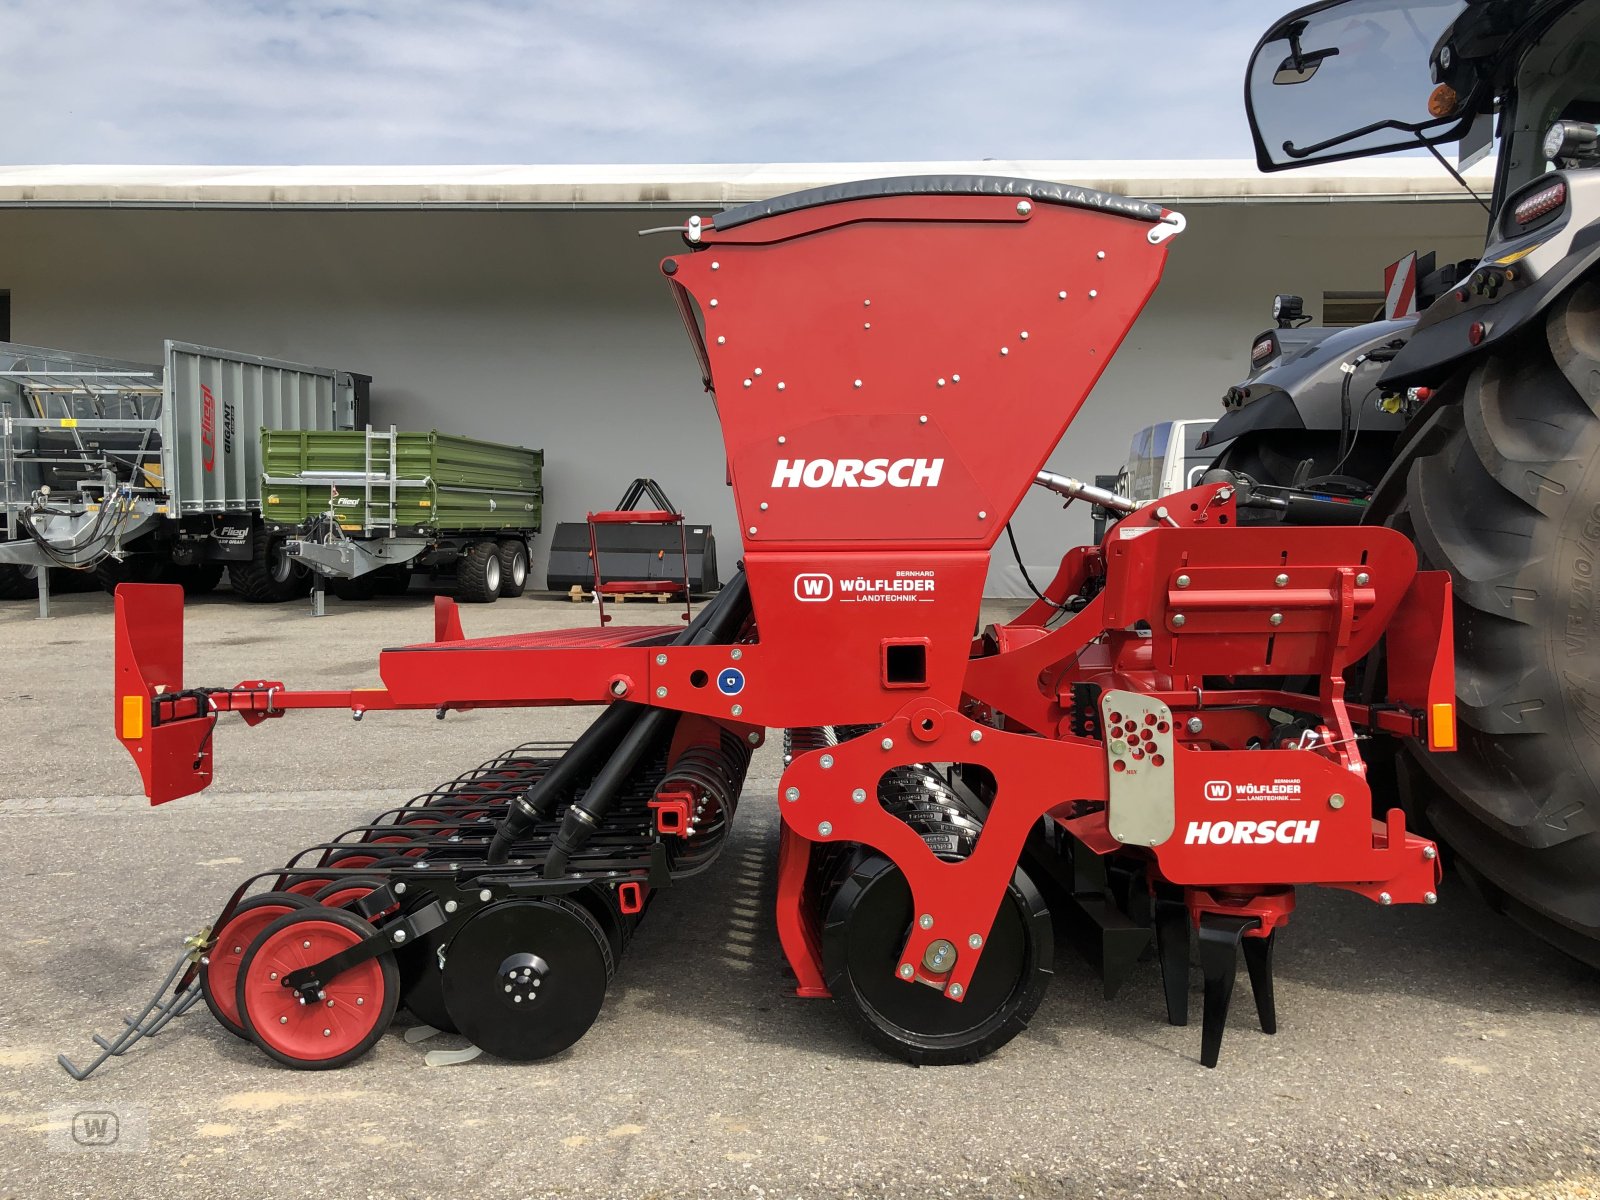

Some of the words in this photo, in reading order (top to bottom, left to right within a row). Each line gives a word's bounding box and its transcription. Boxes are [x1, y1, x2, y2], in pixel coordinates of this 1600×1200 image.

[200, 383, 215, 446] Fliegl
[771, 458, 944, 488] HORSCH
[337, 497, 360, 508] Fliegl
[221, 526, 249, 540] Fliegl
[803, 580, 823, 595] W
[840, 577, 935, 592] WÖLFLEDER
[856, 594, 917, 602] LANDTECHNIK
[1210, 785, 1226, 797] W
[1236, 783, 1301, 794] WÖLFLEDER
[1184, 820, 1320, 844] HORSCH
